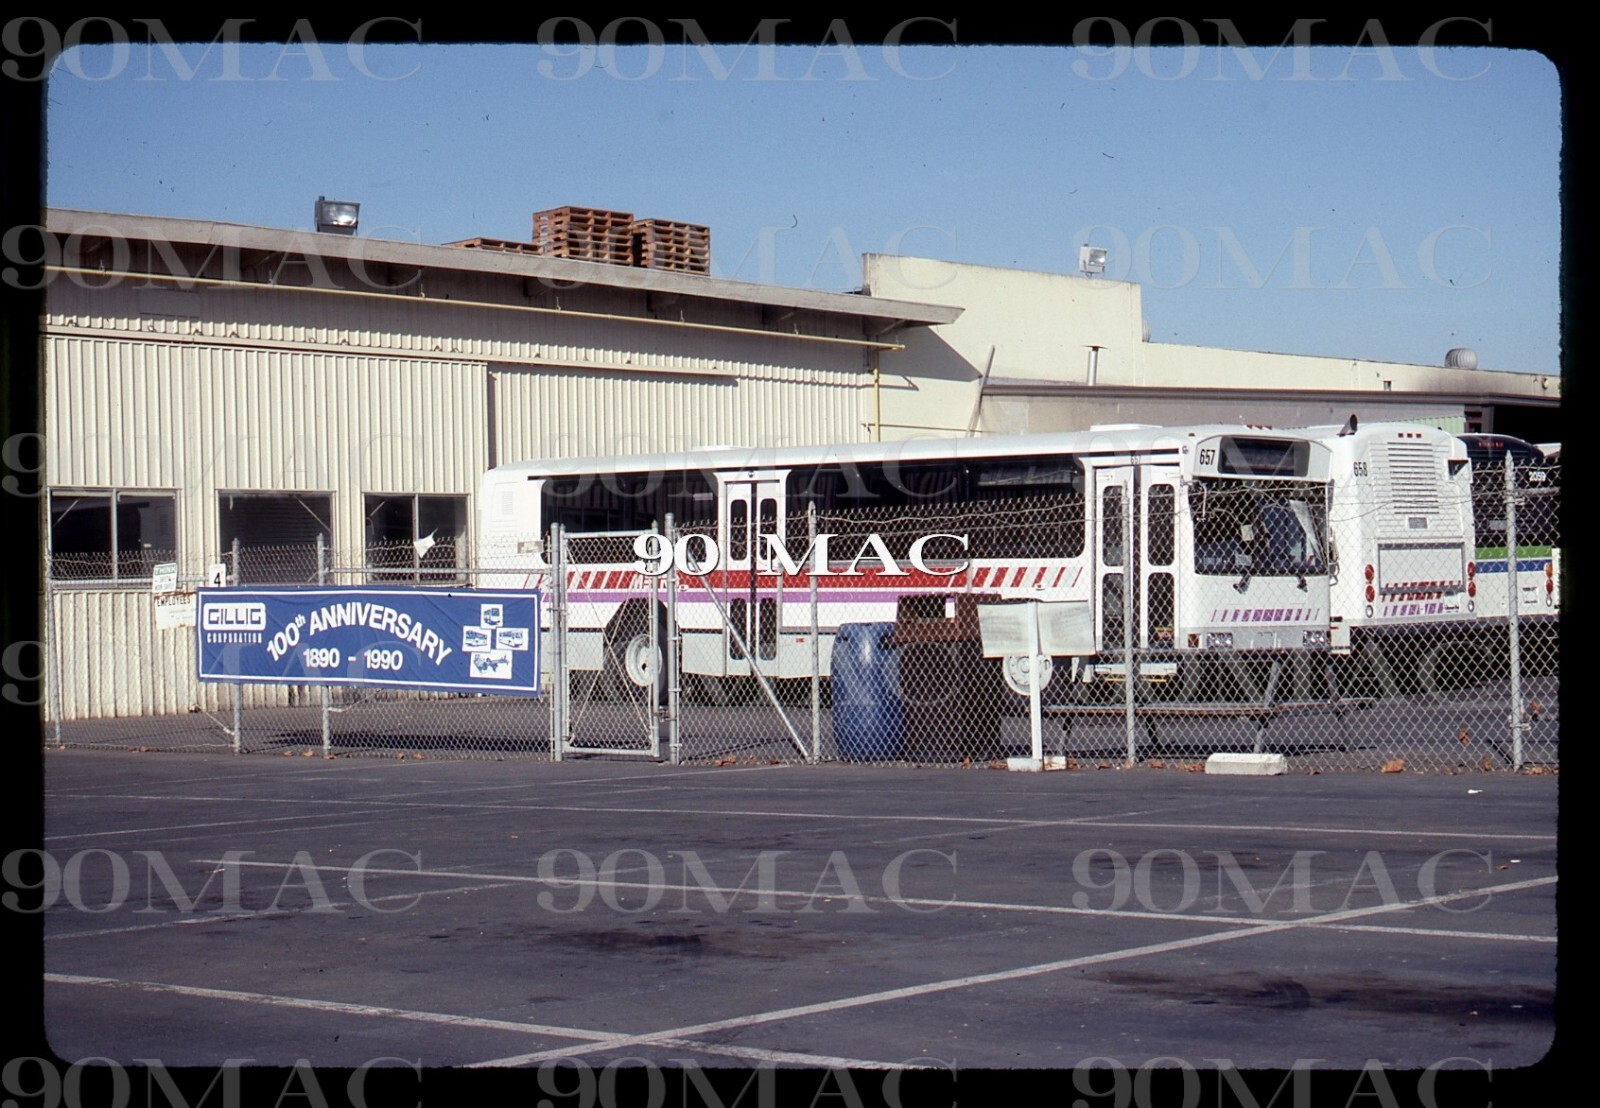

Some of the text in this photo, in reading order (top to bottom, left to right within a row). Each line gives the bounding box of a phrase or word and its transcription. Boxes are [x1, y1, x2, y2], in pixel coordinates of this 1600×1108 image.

[1200, 449, 1215, 465] 657
[1353, 462, 1368, 477] 658
[213, 572, 221, 588] 4
[157, 595, 191, 607] EMPLOYEES
[208, 608, 262, 625] GILLIG
[206, 632, 263, 644] CORPORATION
[266, 602, 453, 667] 100th ANNIVERSARY
[302, 648, 341, 668] 1890
[363, 649, 404, 671] 1990
